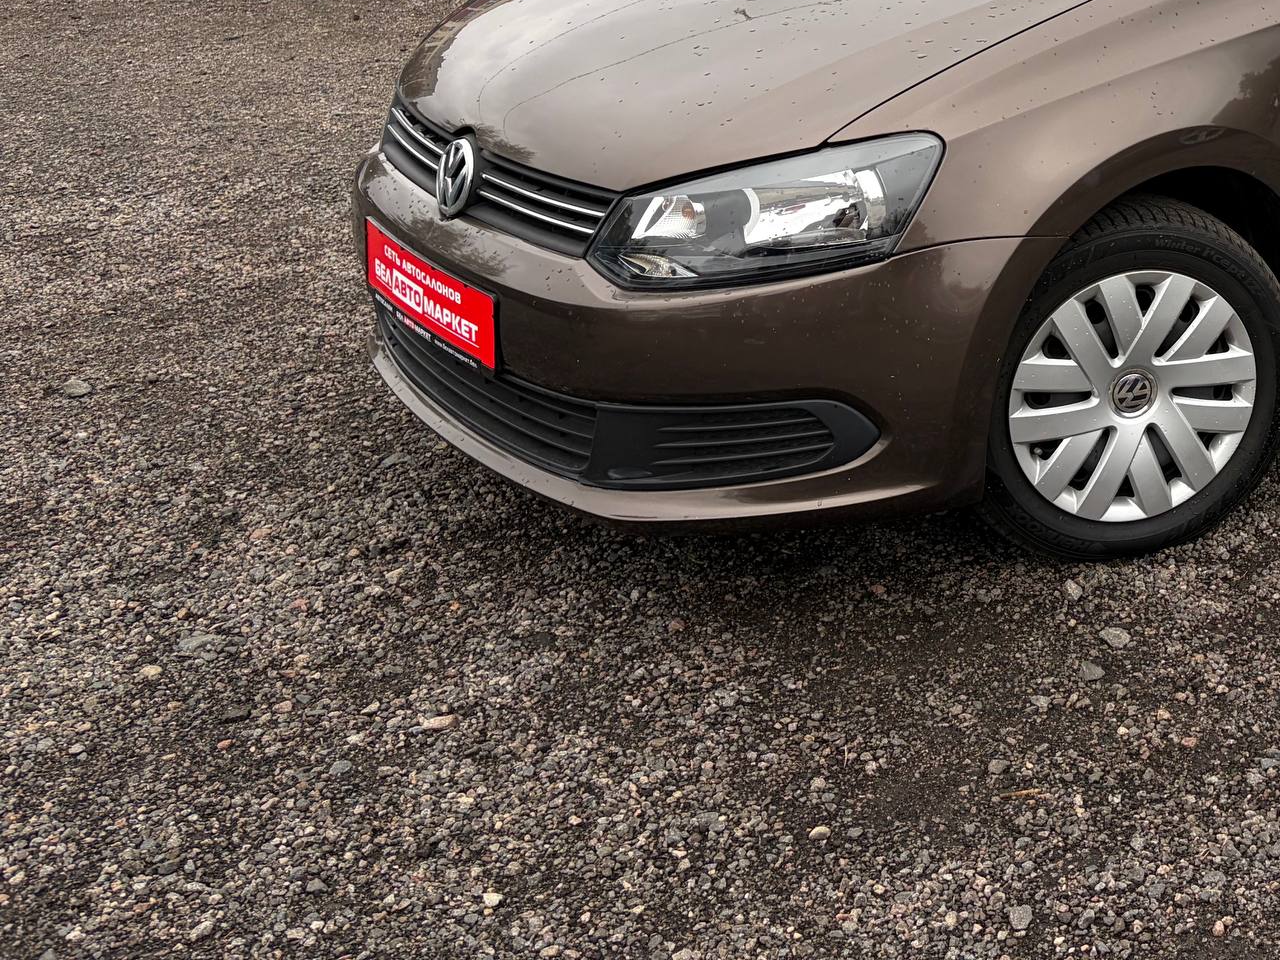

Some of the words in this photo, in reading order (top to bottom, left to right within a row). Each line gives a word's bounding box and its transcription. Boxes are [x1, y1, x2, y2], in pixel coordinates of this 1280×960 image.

[384, 245, 402, 266] СЕТЬ
[402, 259, 462, 304] АВТОСАЛОНОВ
[1155, 238, 1202, 254] Winter
[374, 258, 392, 286] БЕЛ
[394, 275, 422, 308] АВТО
[424, 296, 478, 343] МАРКЕТ
